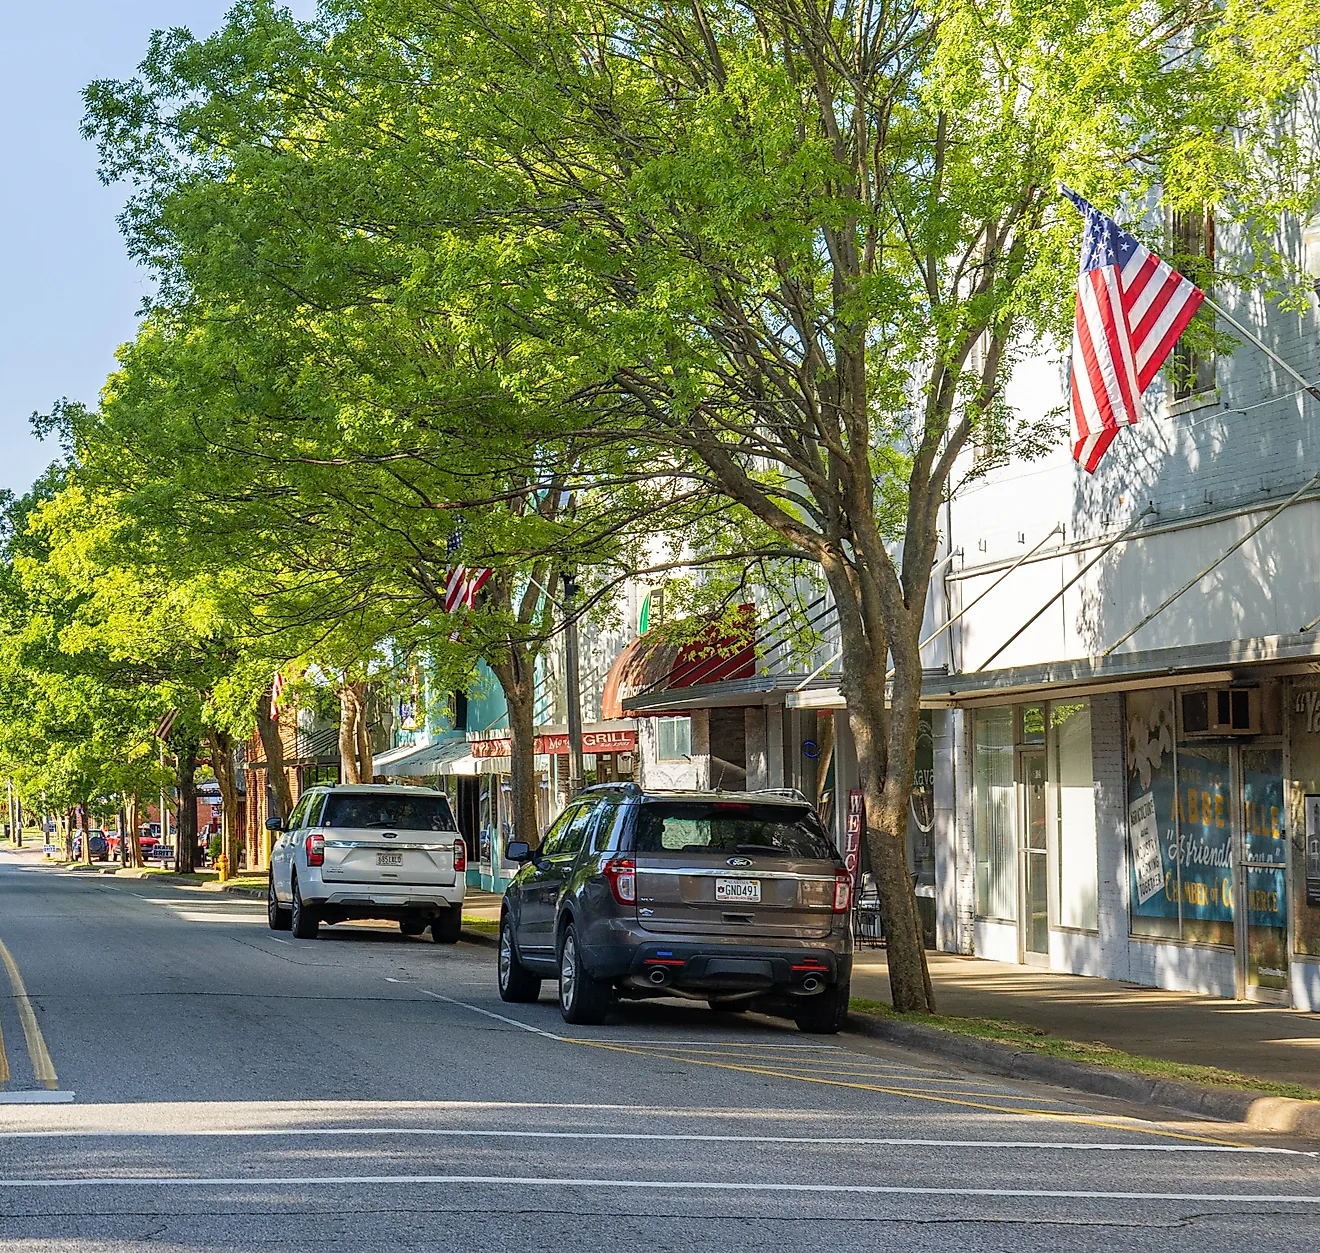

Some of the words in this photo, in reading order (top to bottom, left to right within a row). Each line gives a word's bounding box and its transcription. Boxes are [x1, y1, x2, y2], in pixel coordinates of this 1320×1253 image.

[583, 732, 631, 746] GRILL
[1170, 787, 1280, 839] ABBEILLE
[725, 884, 758, 896] GND491
